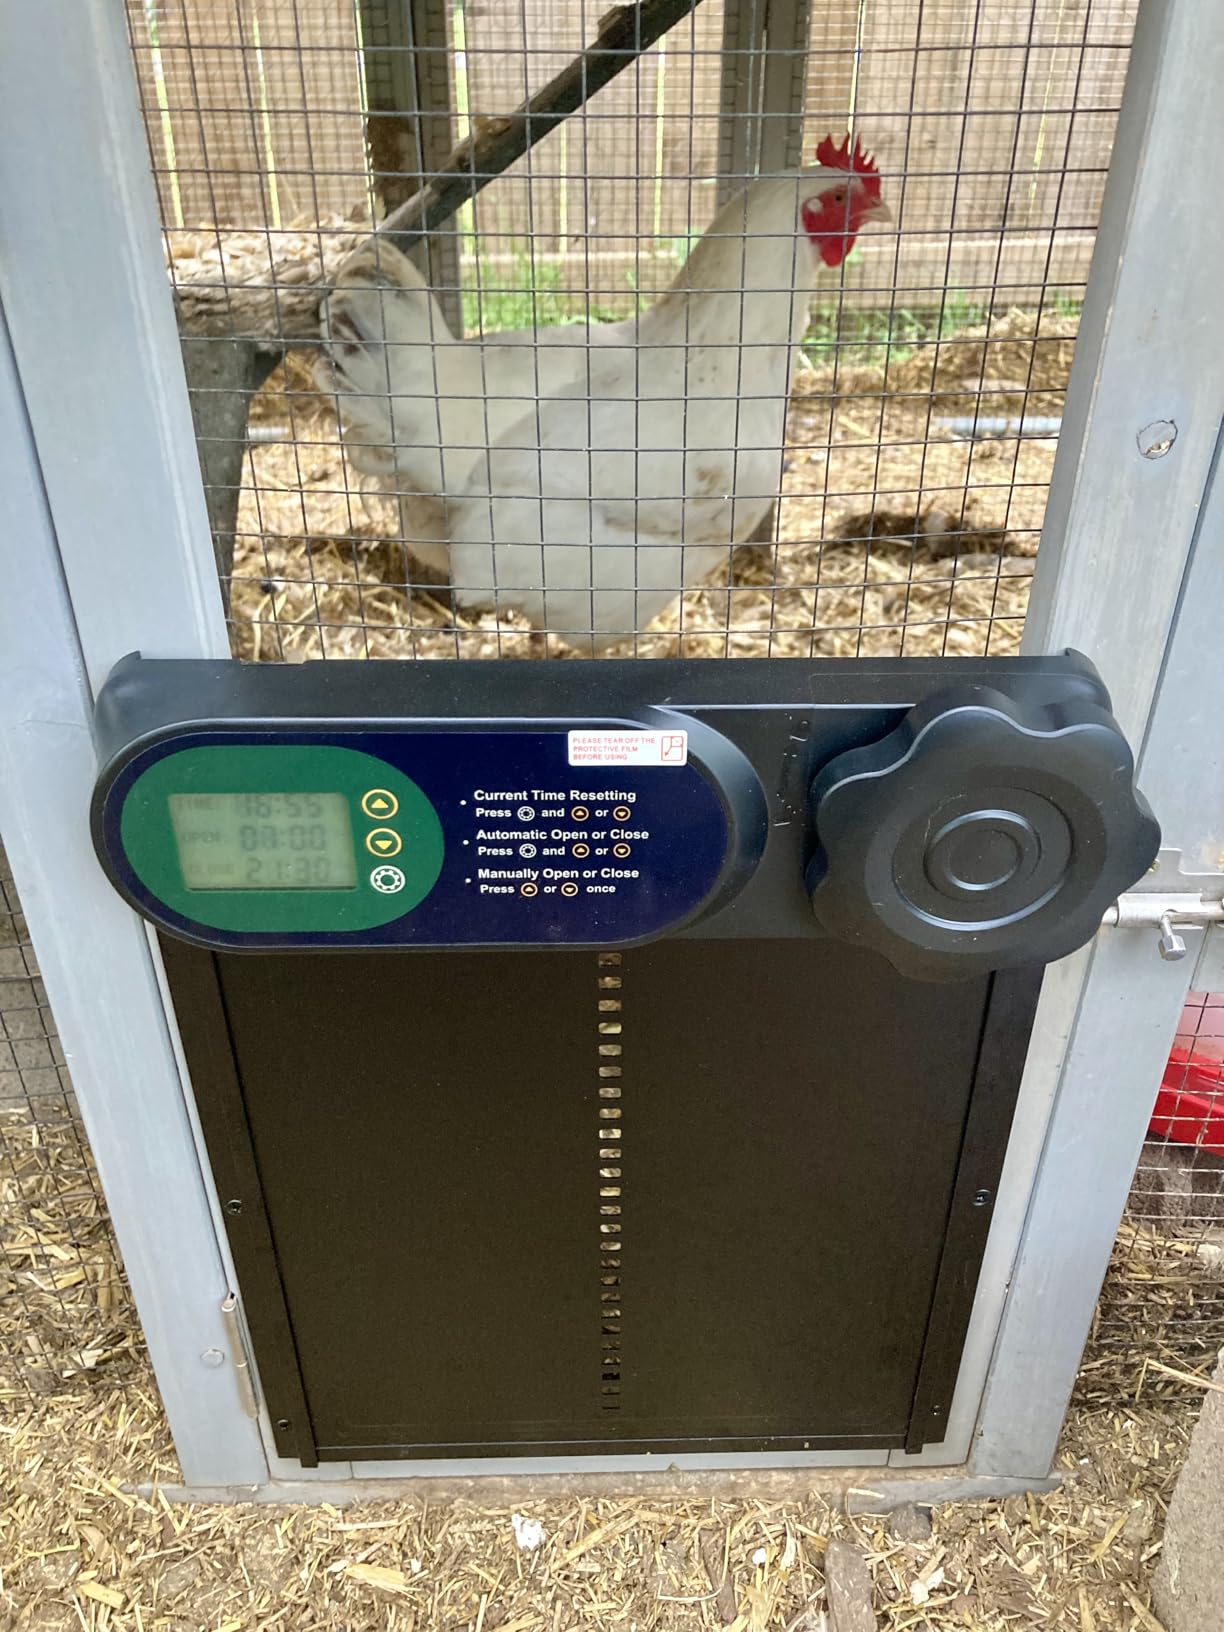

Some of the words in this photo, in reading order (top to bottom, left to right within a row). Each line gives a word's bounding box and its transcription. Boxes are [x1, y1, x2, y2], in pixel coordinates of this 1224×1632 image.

[474, 790, 528, 801] Current
[531, 789, 565, 801] Time
[570, 789, 637, 803] Resetting
[476, 808, 512, 818] Press
[541, 808, 565, 817] and
[595, 809, 608, 817] or
[476, 829, 547, 840] Automatic
[551, 829, 588, 841] Open
[592, 831, 607, 840] or
[610, 829, 649, 840] Close
[478, 846, 513, 856] Press
[542, 846, 565, 855] and
[478, 869, 539, 880] Manually
[543, 868, 579, 880] Open
[583, 869, 597, 878] or
[601, 868, 639, 878] Close
[480, 884, 515, 894] Press
[544, 885, 557, 894] or
[586, 885, 616, 893] once
